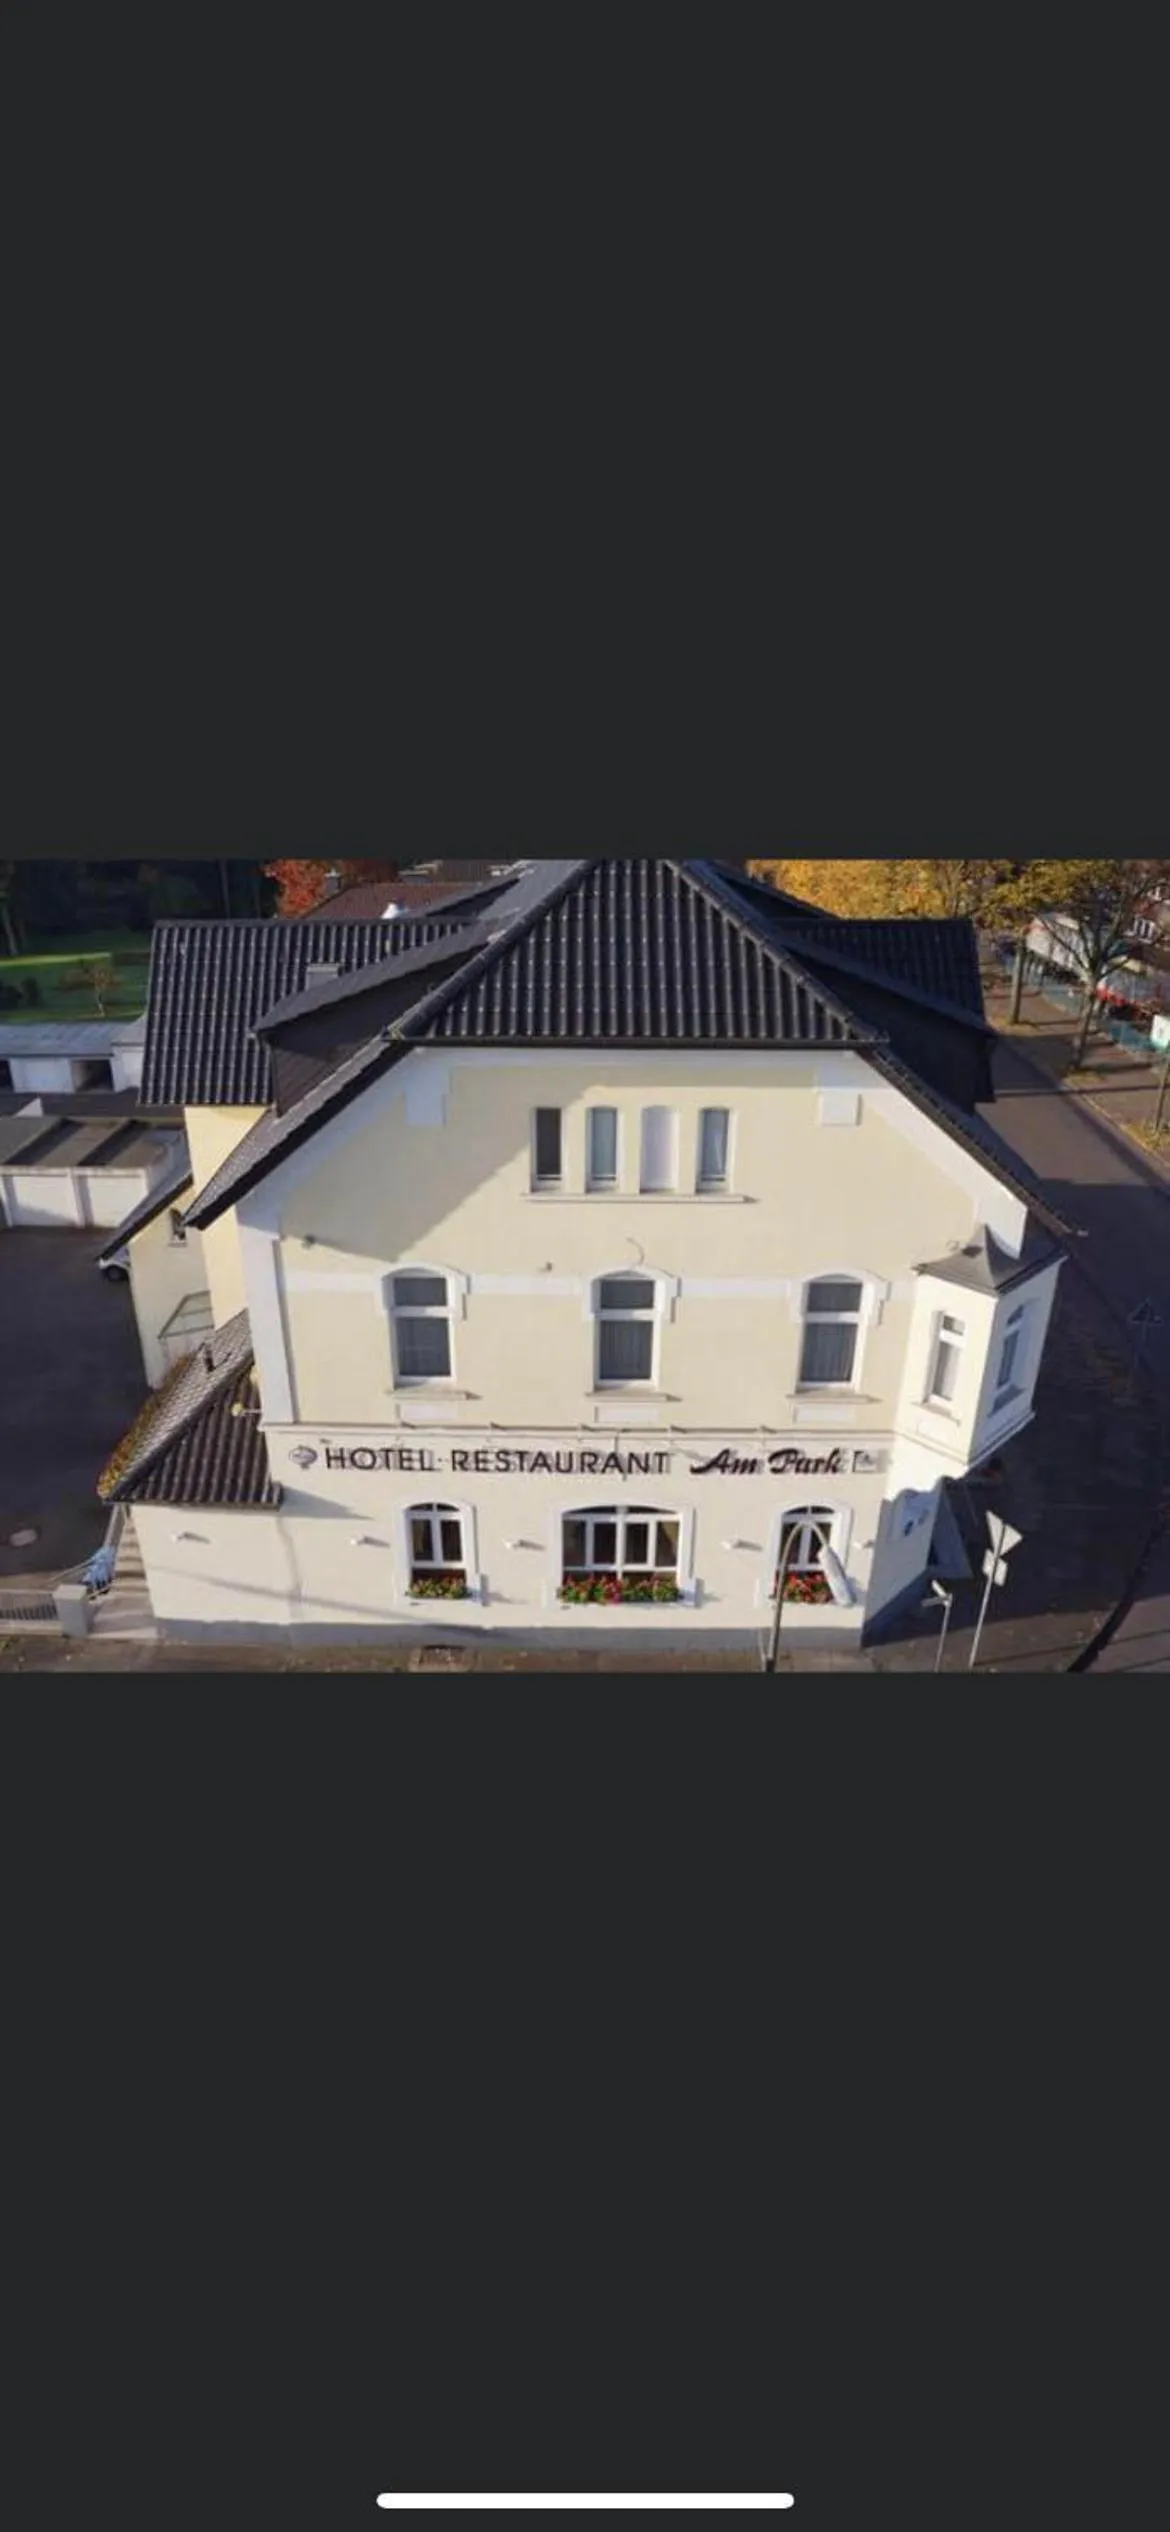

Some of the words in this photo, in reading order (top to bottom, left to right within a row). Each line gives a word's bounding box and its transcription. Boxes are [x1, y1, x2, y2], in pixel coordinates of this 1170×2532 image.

[325, 1447, 434, 1472] HOTEL
[450, 1448, 670, 1474] RESTAURANT
[690, 1448, 758, 1475] Am
[767, 1447, 842, 1475] Park
